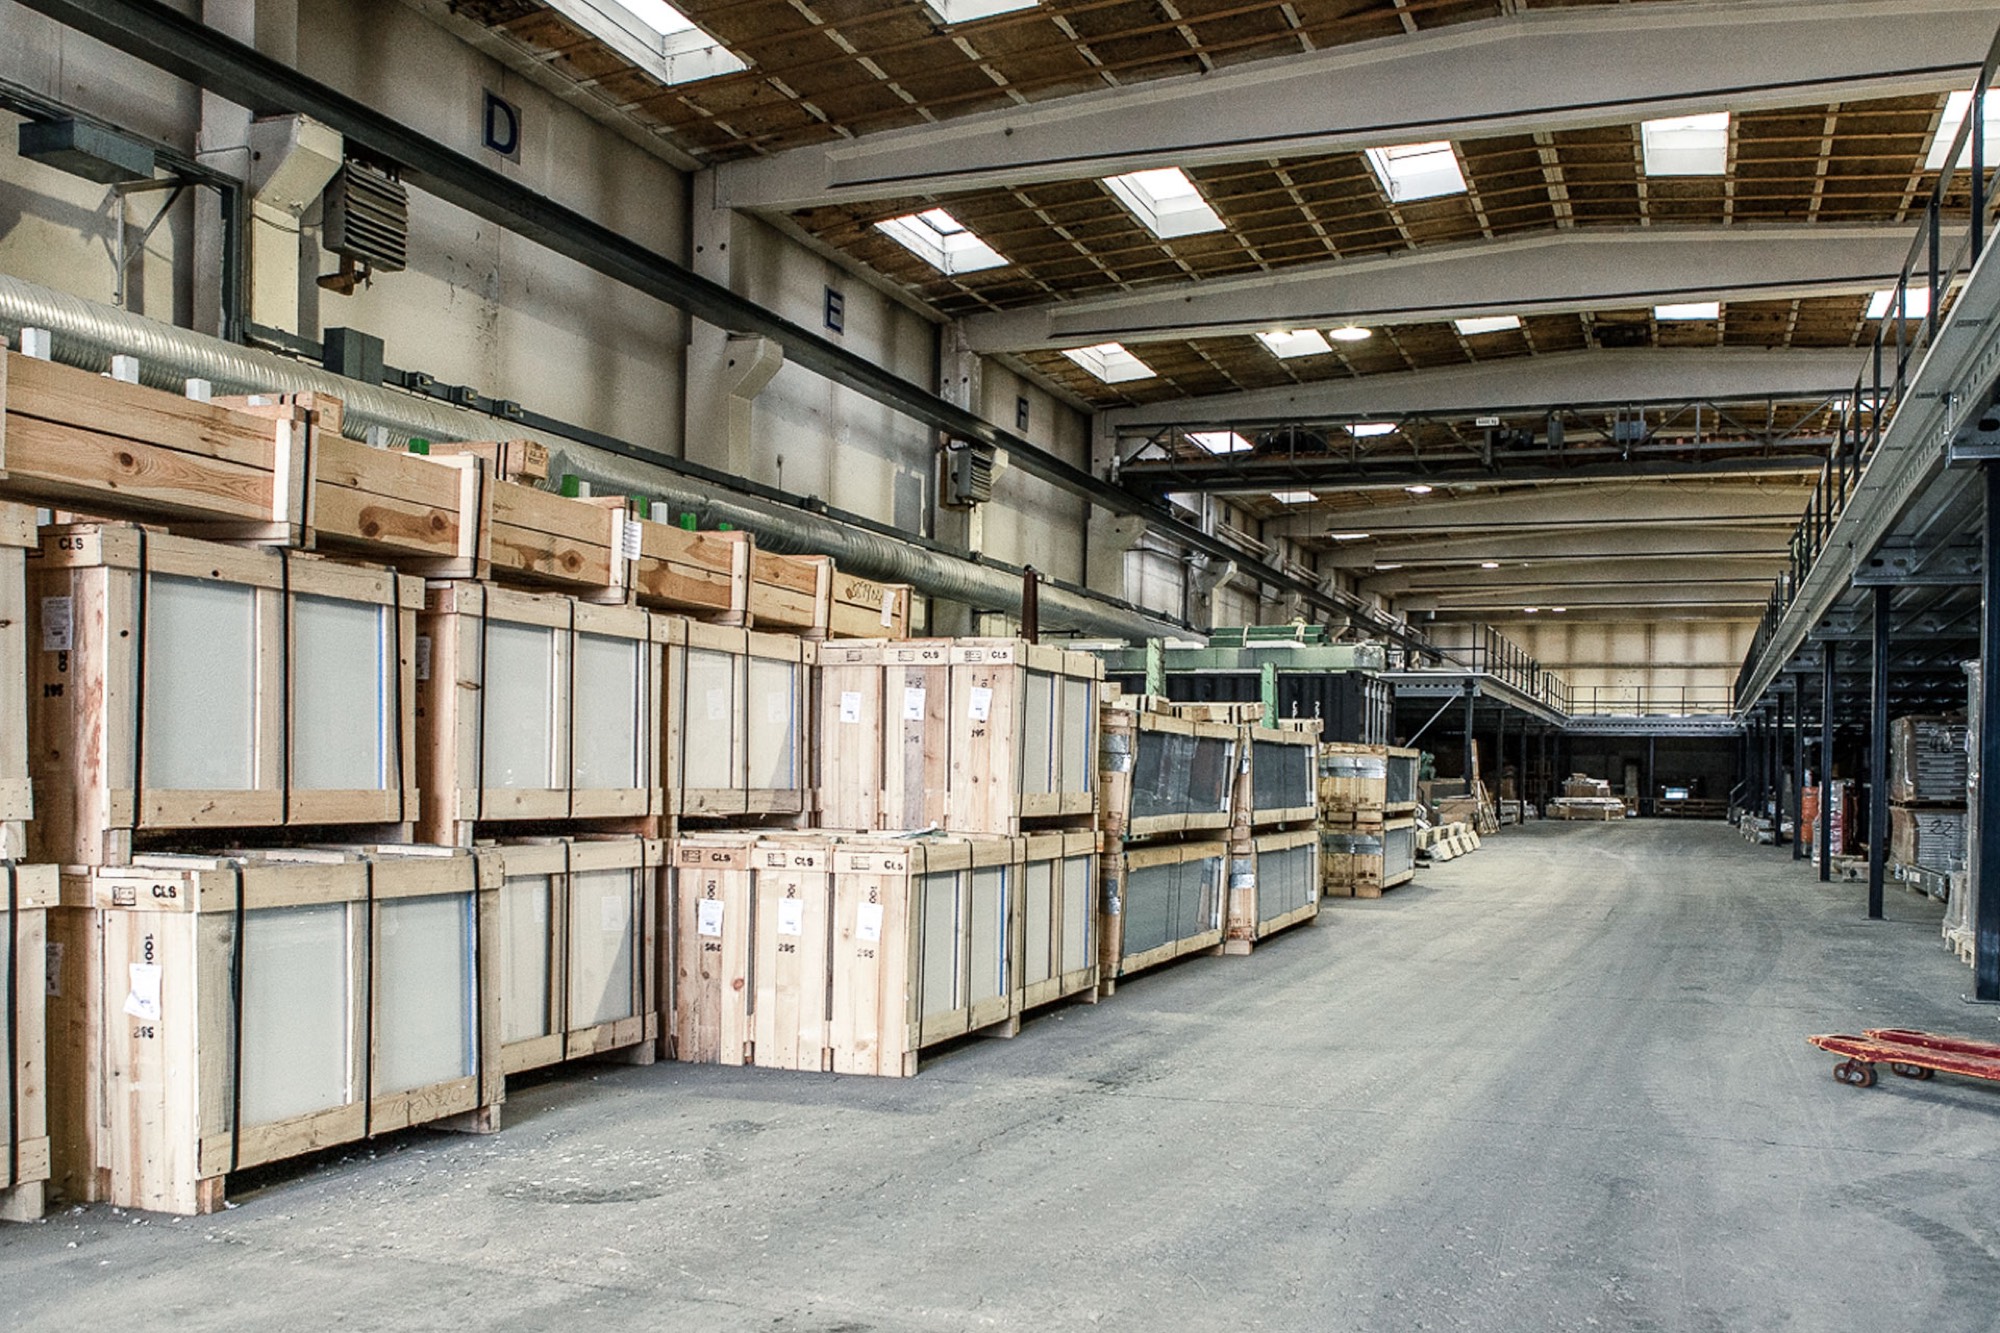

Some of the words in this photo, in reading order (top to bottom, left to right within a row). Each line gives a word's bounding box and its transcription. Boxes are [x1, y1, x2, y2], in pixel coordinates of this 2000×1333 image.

[486, 92, 518, 154] D
[826, 288, 843, 333] E
[1017, 396, 1029, 429] F
[59, 537, 84, 550] CLS
[991, 650, 1008, 659] CLS
[711, 853, 731, 862] CLS
[794, 856, 814, 867] CLS
[884, 860, 904, 871] CLS
[152, 884, 177, 899] CLS
